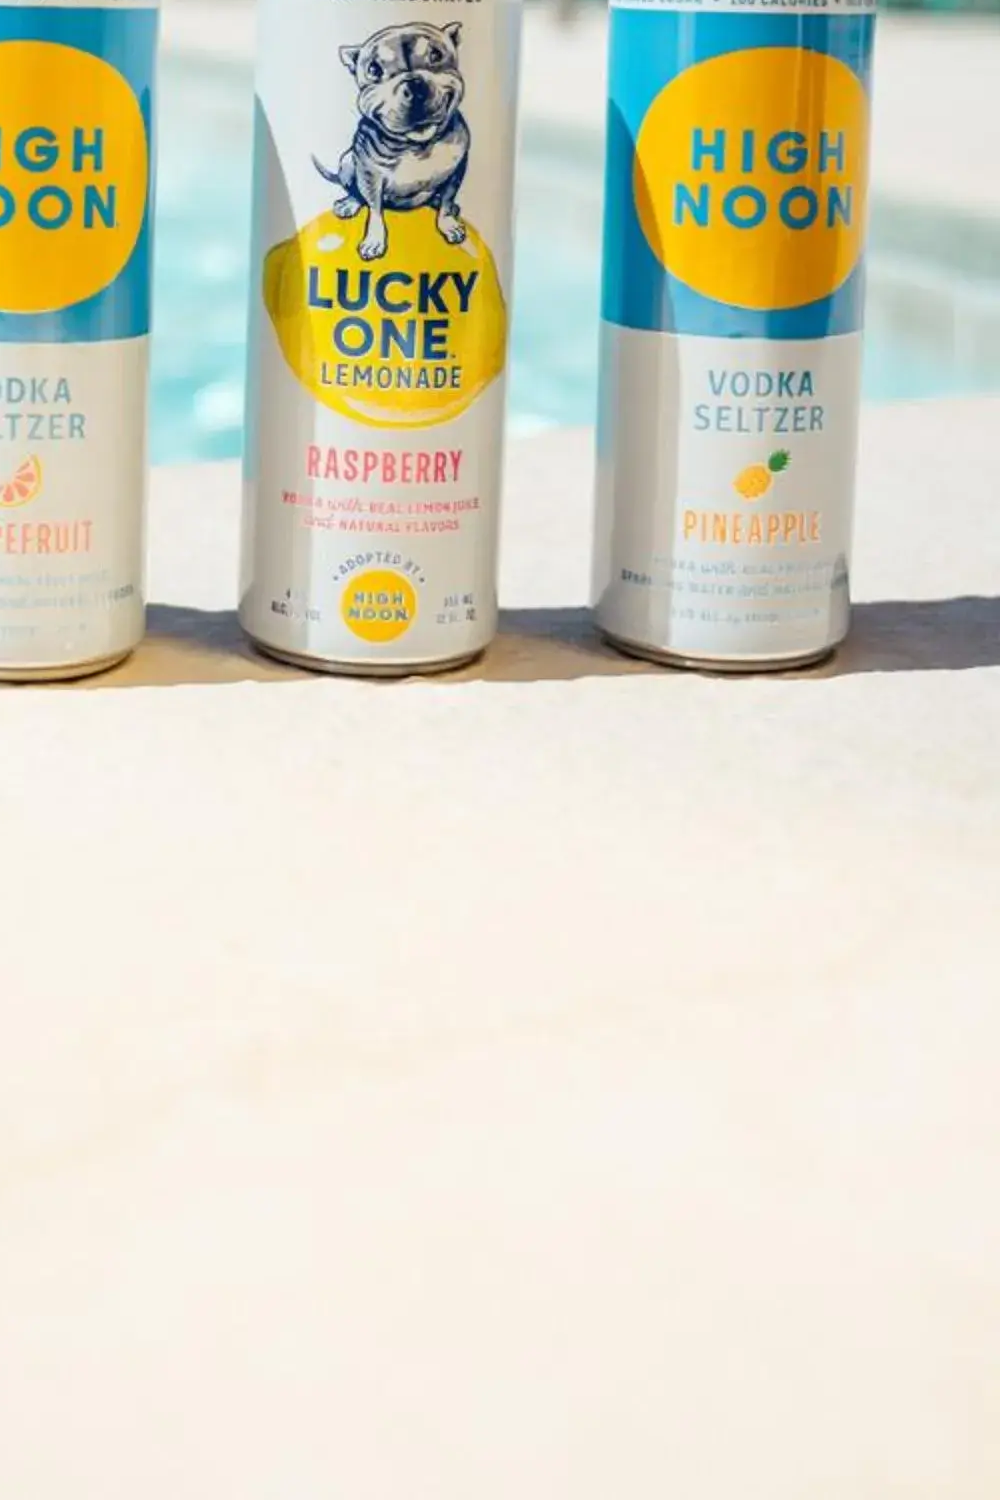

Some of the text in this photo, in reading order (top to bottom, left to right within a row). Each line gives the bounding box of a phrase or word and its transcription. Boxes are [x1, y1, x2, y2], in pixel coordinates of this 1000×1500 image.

[691, 129, 845, 174] HIGH
[673, 183, 852, 230] NOON
[308, 266, 478, 314] LUCKY
[333, 316, 450, 360] ONE
[321, 363, 462, 389] LEMONADE
[708, 371, 814, 398] VODKA
[693, 405, 824, 432] SELTZER
[307, 445, 463, 484] RASPBERRY
[684, 510, 821, 544] PINEAPPLE
[338, 551, 401, 575] ADOPTED
[353, 592, 404, 606] HIGH
[348, 607, 409, 622] NOON
